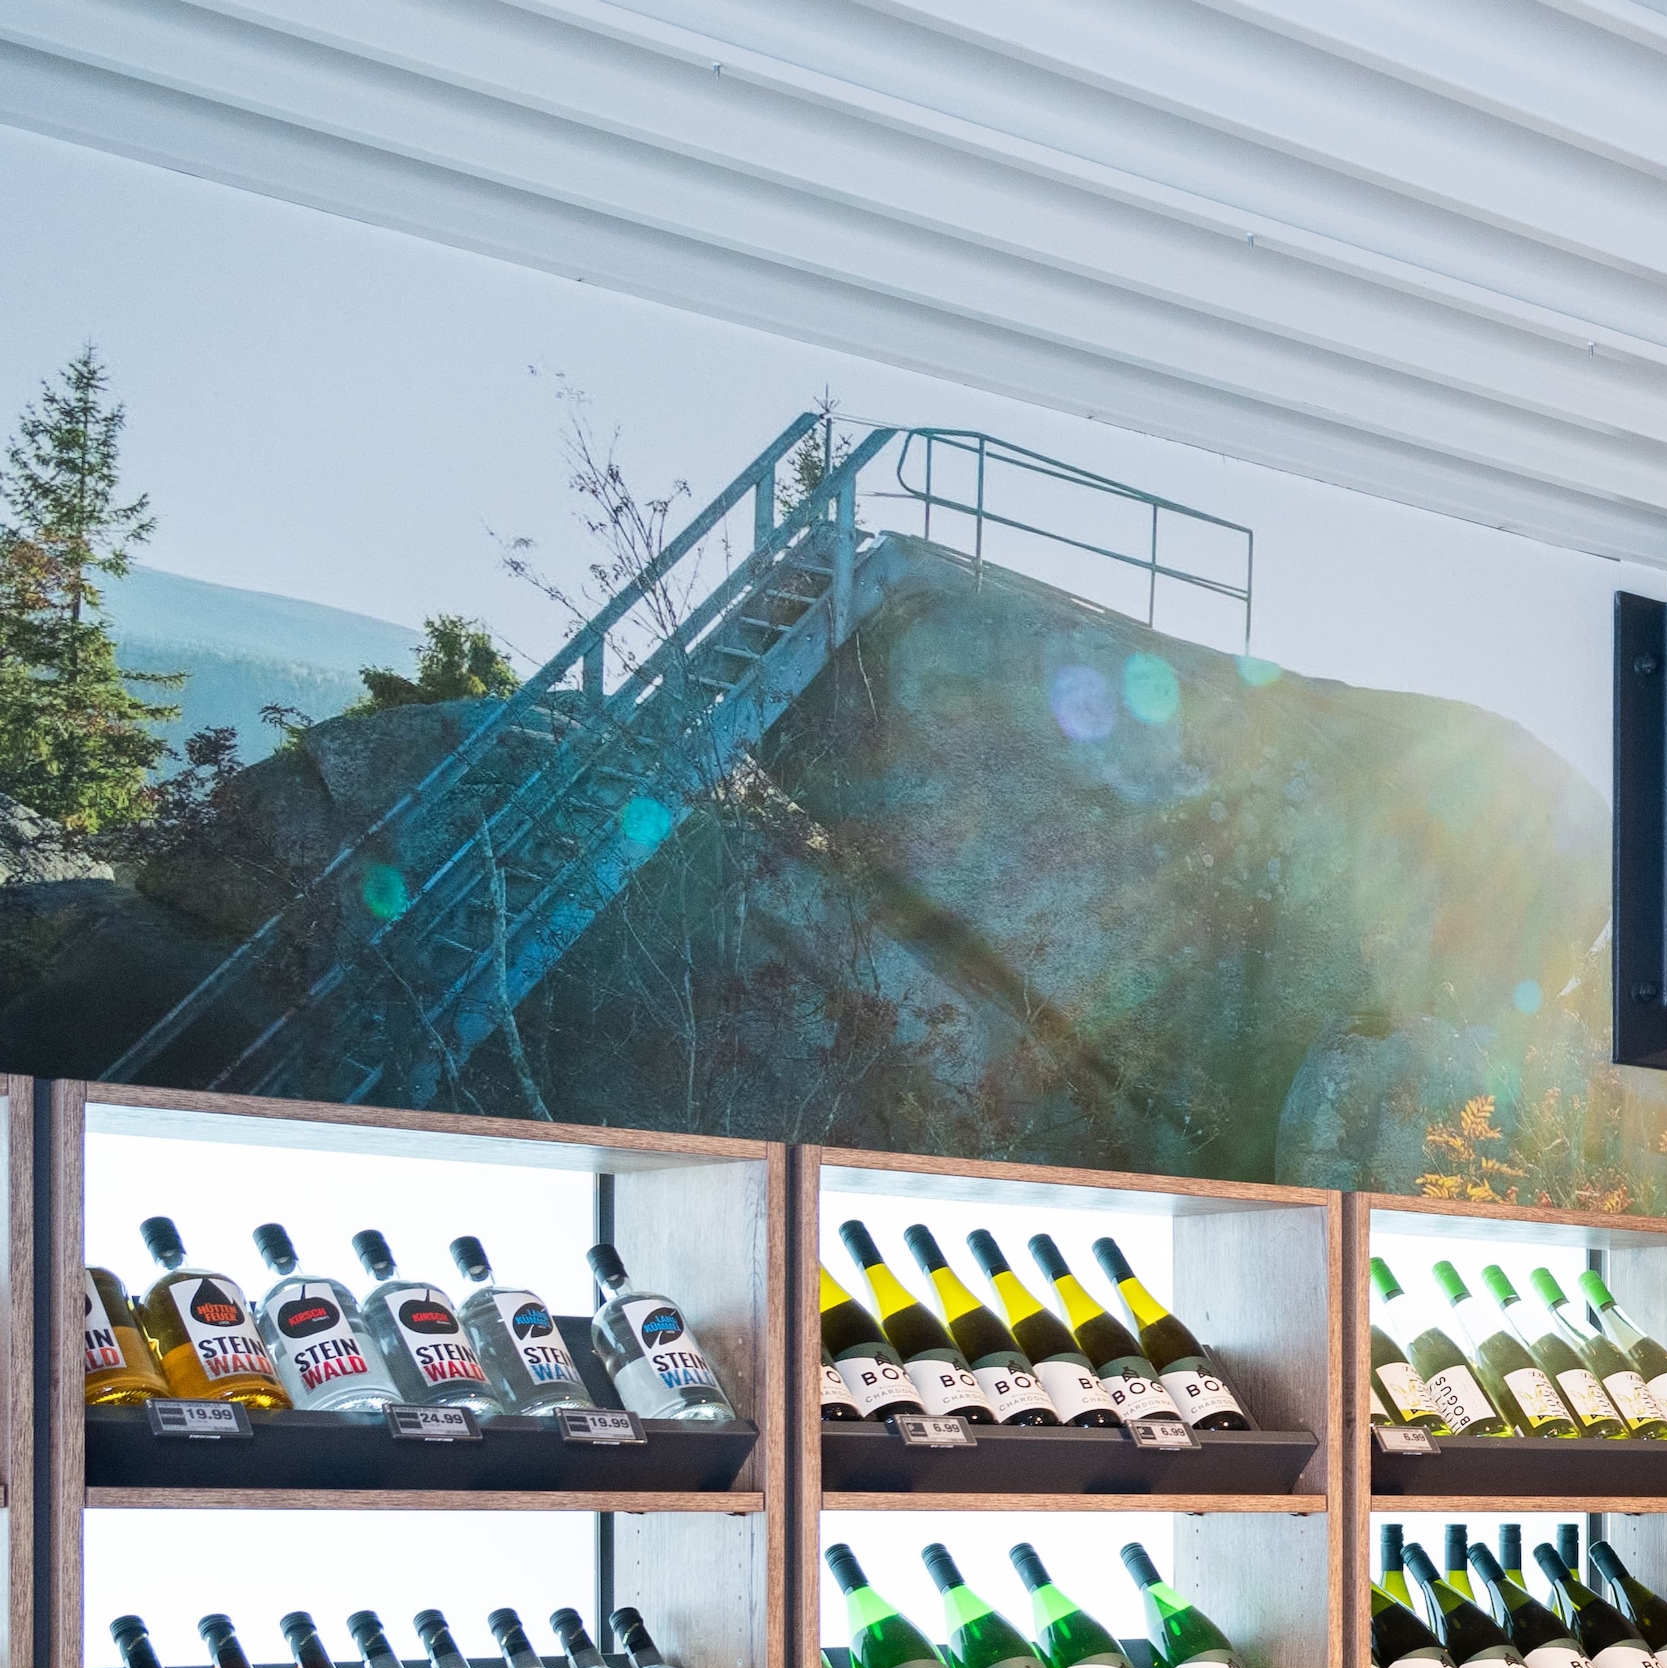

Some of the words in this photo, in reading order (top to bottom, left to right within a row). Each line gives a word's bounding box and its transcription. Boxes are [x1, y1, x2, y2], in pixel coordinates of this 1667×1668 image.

[288, 1307, 327, 1326] KIRSCH
[411, 1313, 449, 1323] KIRSCH
[199, 1336, 266, 1359] STEIN
[294, 1338, 361, 1373] STEIN
[416, 1343, 479, 1365] STEIN
[85, 1347, 120, 1374] LD
[206, 1353, 275, 1377] WALD
[653, 1352, 710, 1373] STEIN
[301, 1355, 369, 1391] WALD
[423, 1361, 487, 1382] WALD
[939, 1373, 976, 1389] BO
[1185, 1379, 1225, 1398] BO
[1435, 1376, 1472, 1427] BOGUS
[186, 1407, 233, 1421] 19.99
[420, 1412, 464, 1425] 24.99
[589, 1416, 630, 1429] 19.99
[934, 1423, 960, 1434] 6.99
[1161, 1426, 1186, 1438] 6.99
[1403, 1433, 1426, 1443] 6.99
